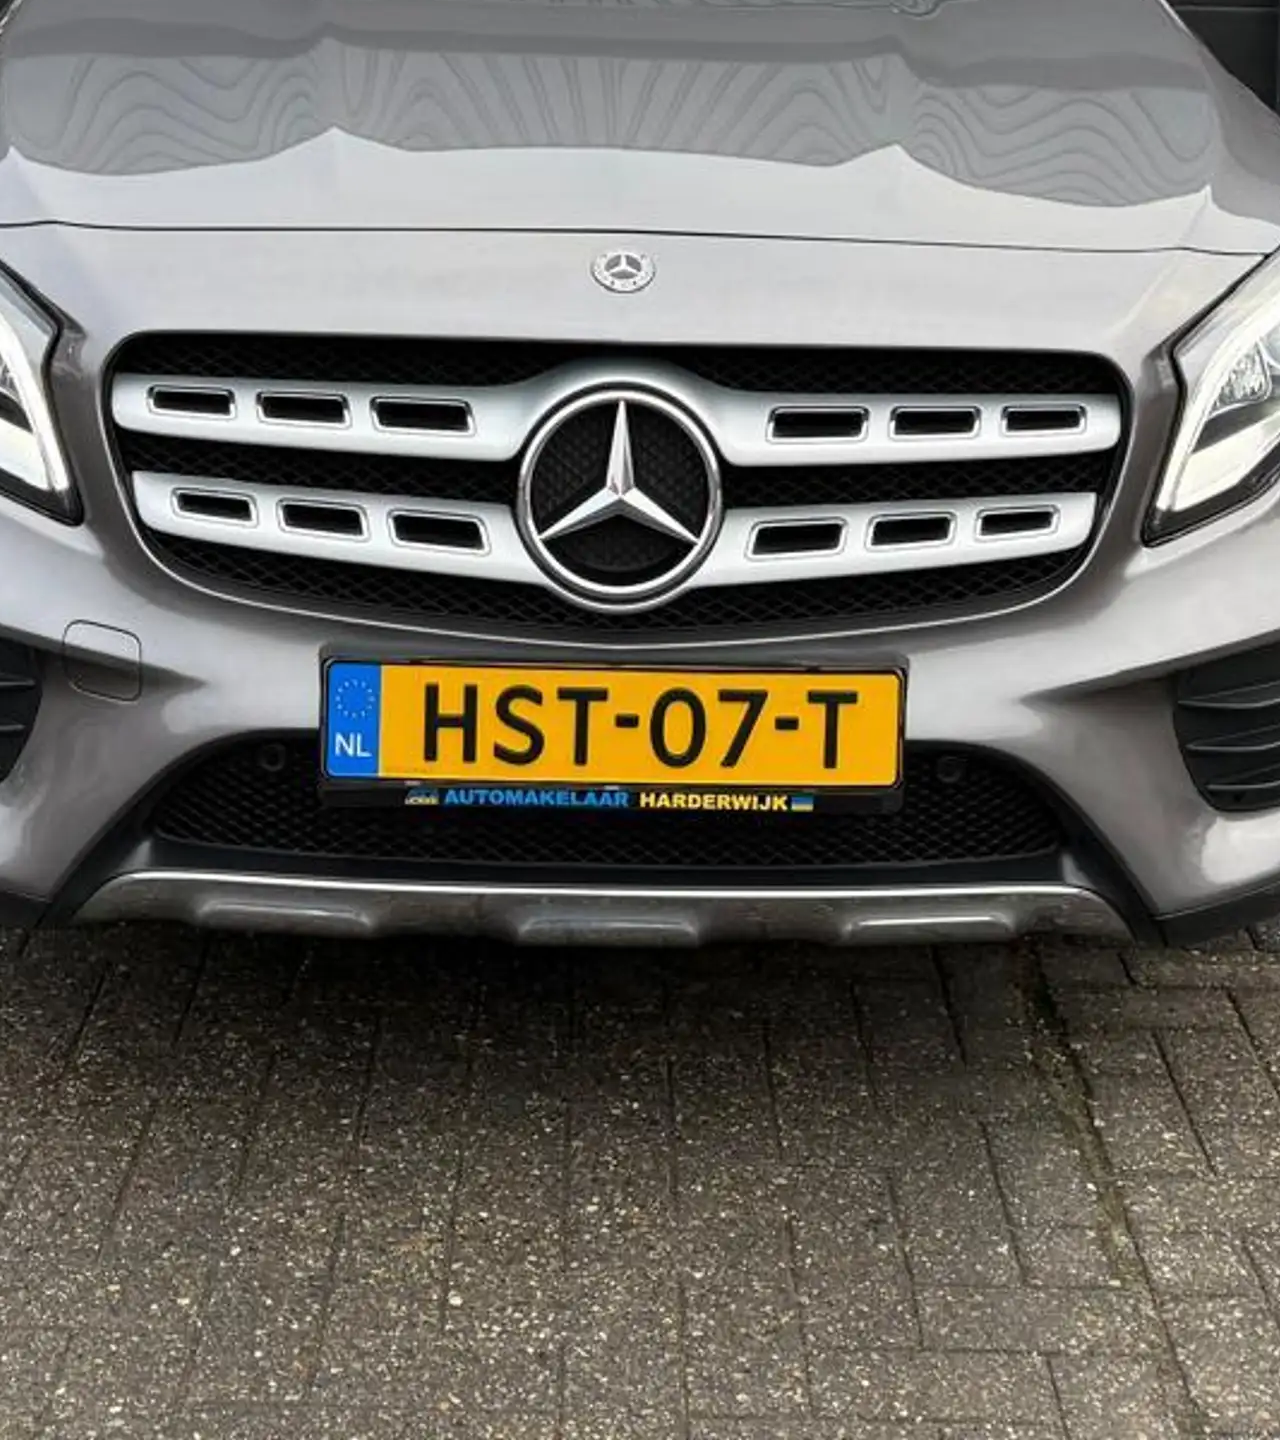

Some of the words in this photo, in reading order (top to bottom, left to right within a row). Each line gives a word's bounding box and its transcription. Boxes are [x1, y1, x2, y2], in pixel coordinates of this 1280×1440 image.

[423, 682, 858, 769] HST-07-T
[335, 732, 372, 758] NL
[444, 788, 629, 807] AUTOMAKELAAR
[639, 791, 789, 811] HARDERWIJK
